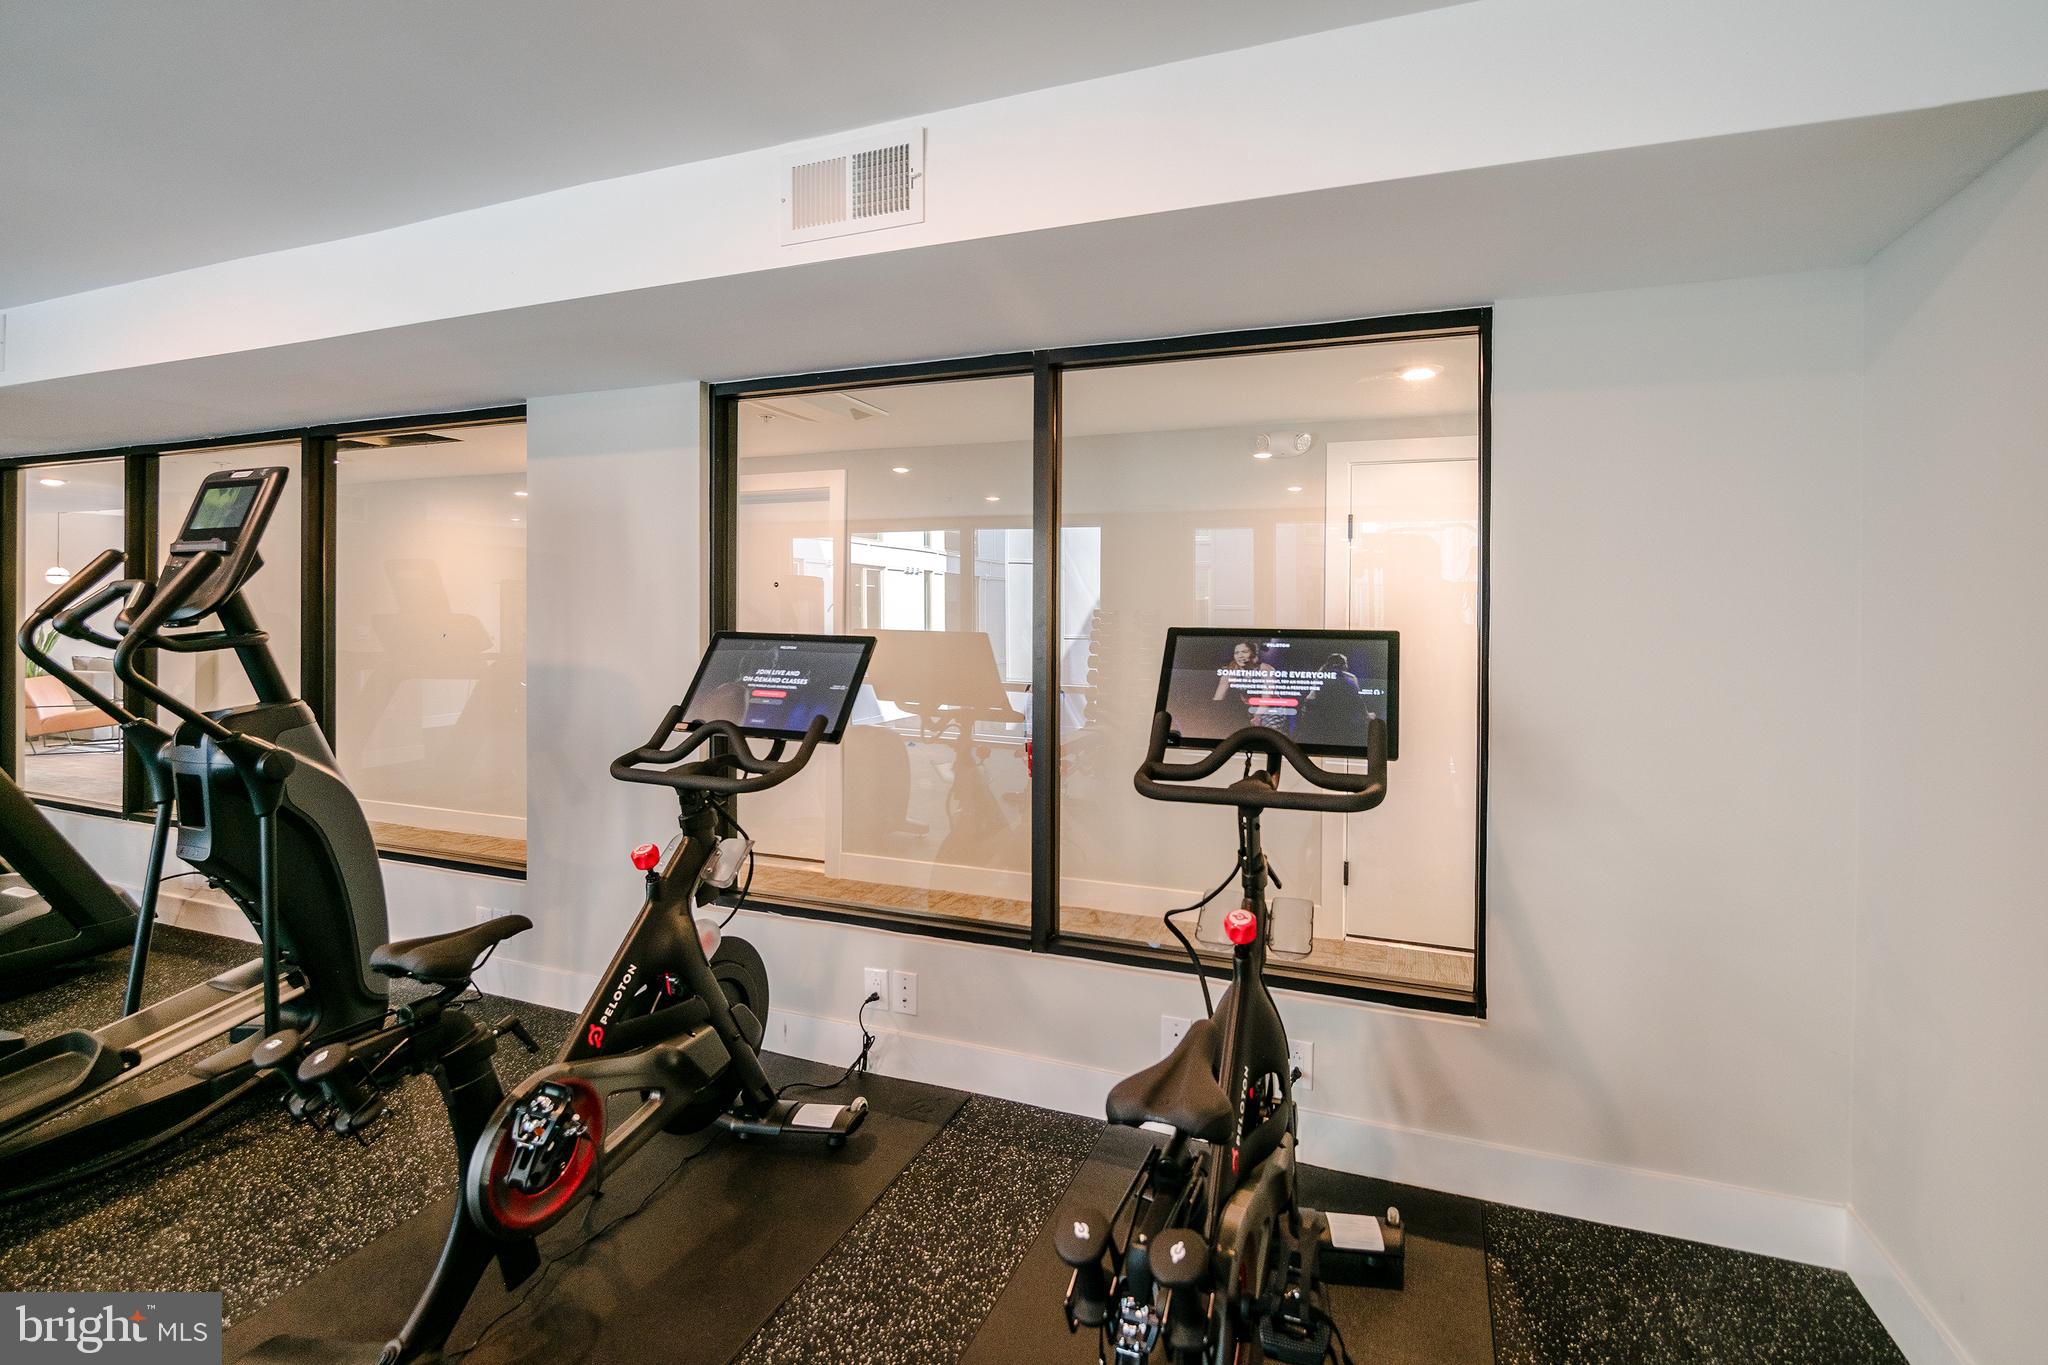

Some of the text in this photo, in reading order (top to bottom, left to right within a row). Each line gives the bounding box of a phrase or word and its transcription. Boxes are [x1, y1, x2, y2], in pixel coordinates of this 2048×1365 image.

[742, 675, 808, 685] ON-DEMAND CLASSES
[1216, 668, 1337, 680] SOMETHING FOR EVERYONE
[599, 963, 638, 1026] PELOTON
